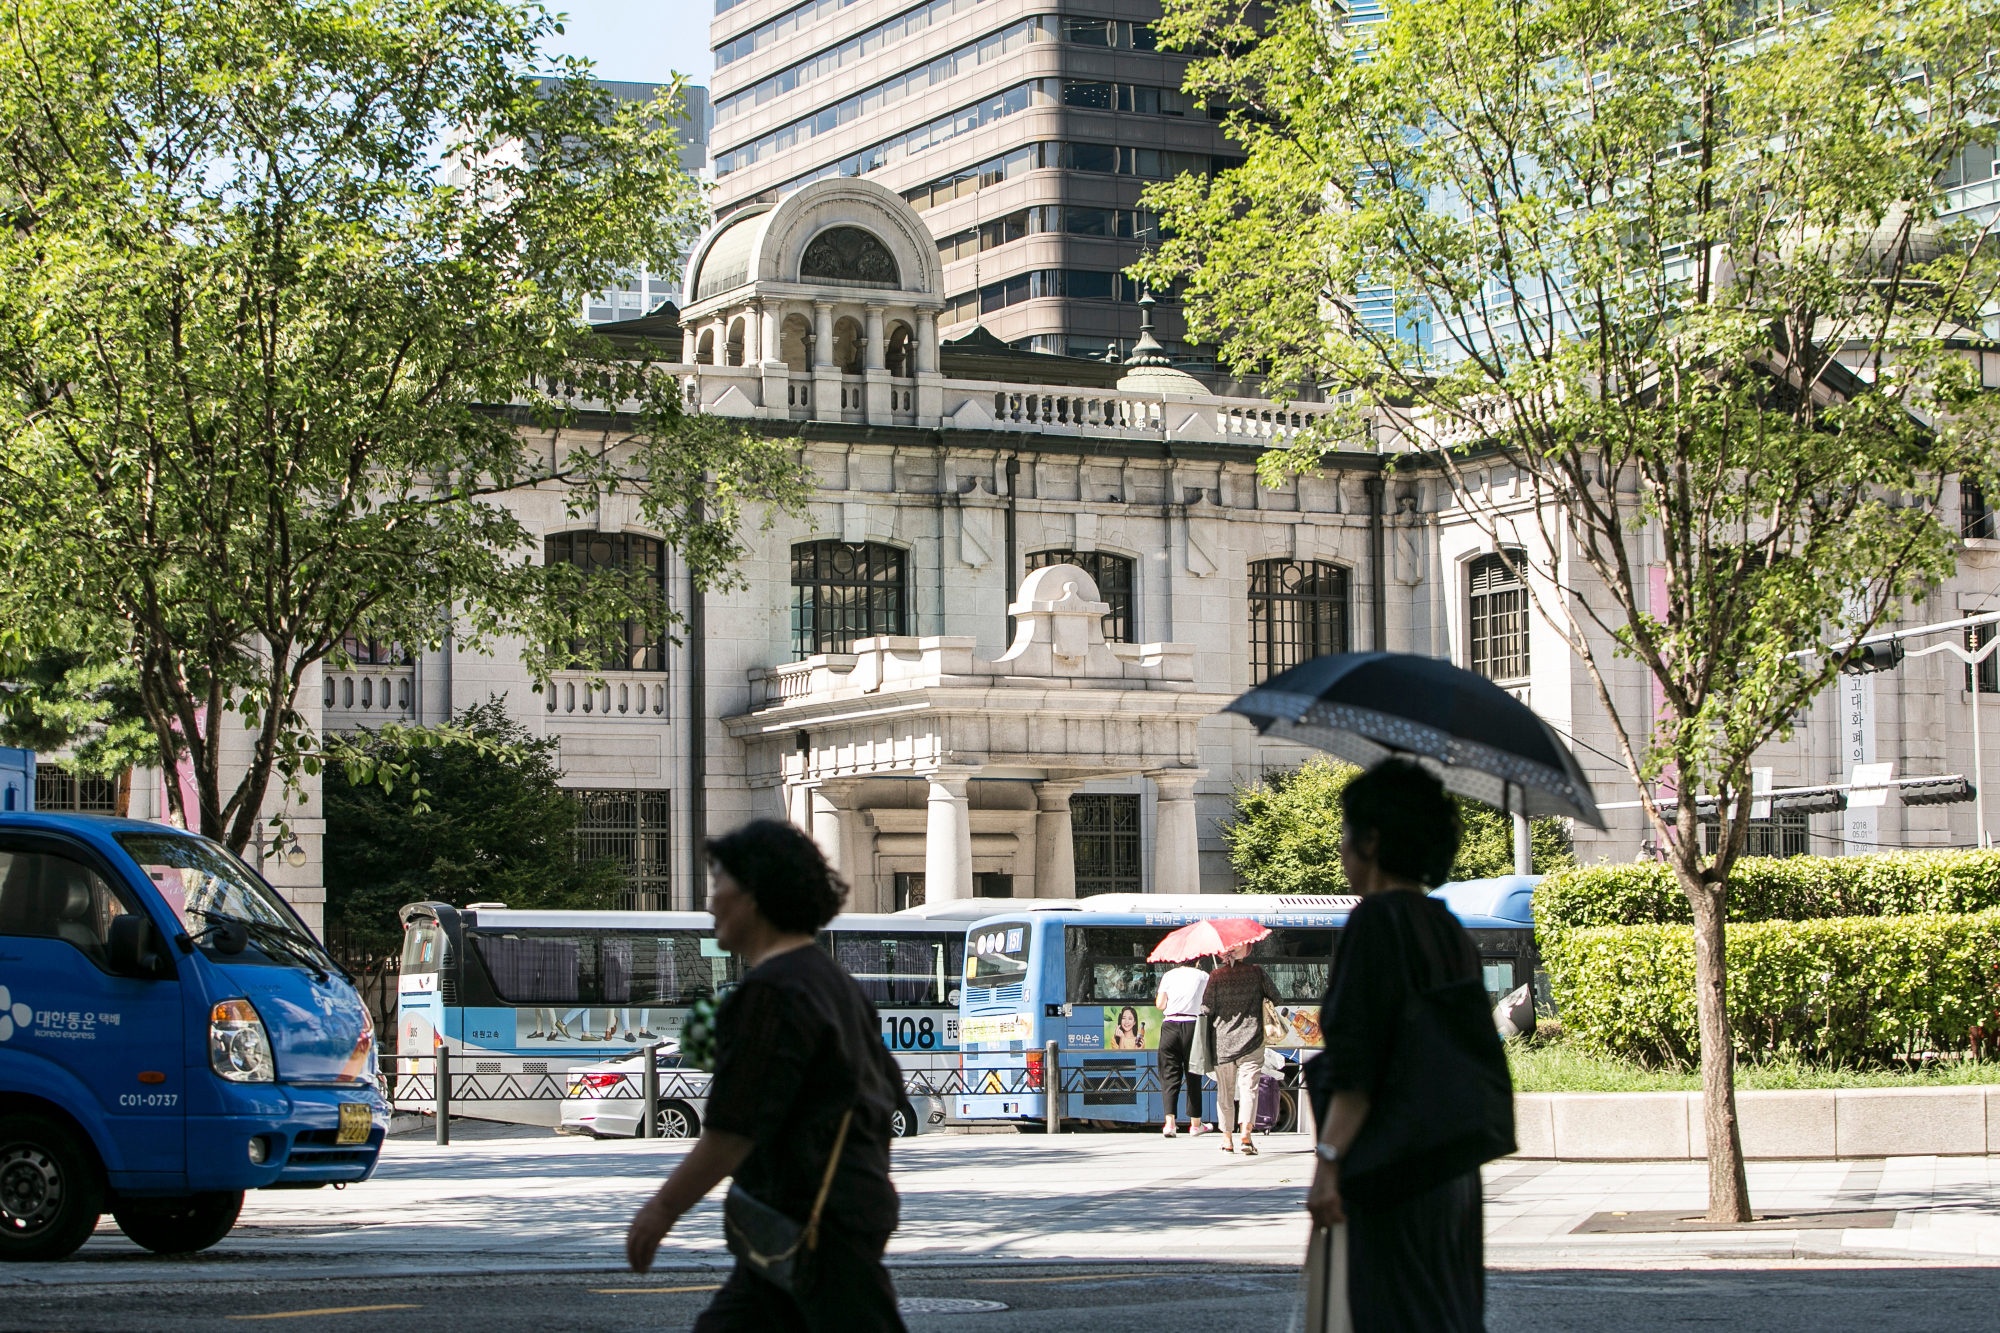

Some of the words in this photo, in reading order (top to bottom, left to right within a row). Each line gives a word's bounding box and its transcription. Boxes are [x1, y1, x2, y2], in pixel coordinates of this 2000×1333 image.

[1852, 821, 1867, 830] 2018
[1009, 931, 1020, 949] 151
[35, 1011, 97, 1030] 대한통운
[98, 1013, 121, 1026] 택배
[62, 1030, 97, 1040] express
[472, 1030, 500, 1039] 대원고속
[877, 1016, 936, 1049] 108
[1067, 1034, 1100, 1043] 동아운수
[119, 1094, 178, 1106] C01-0737
